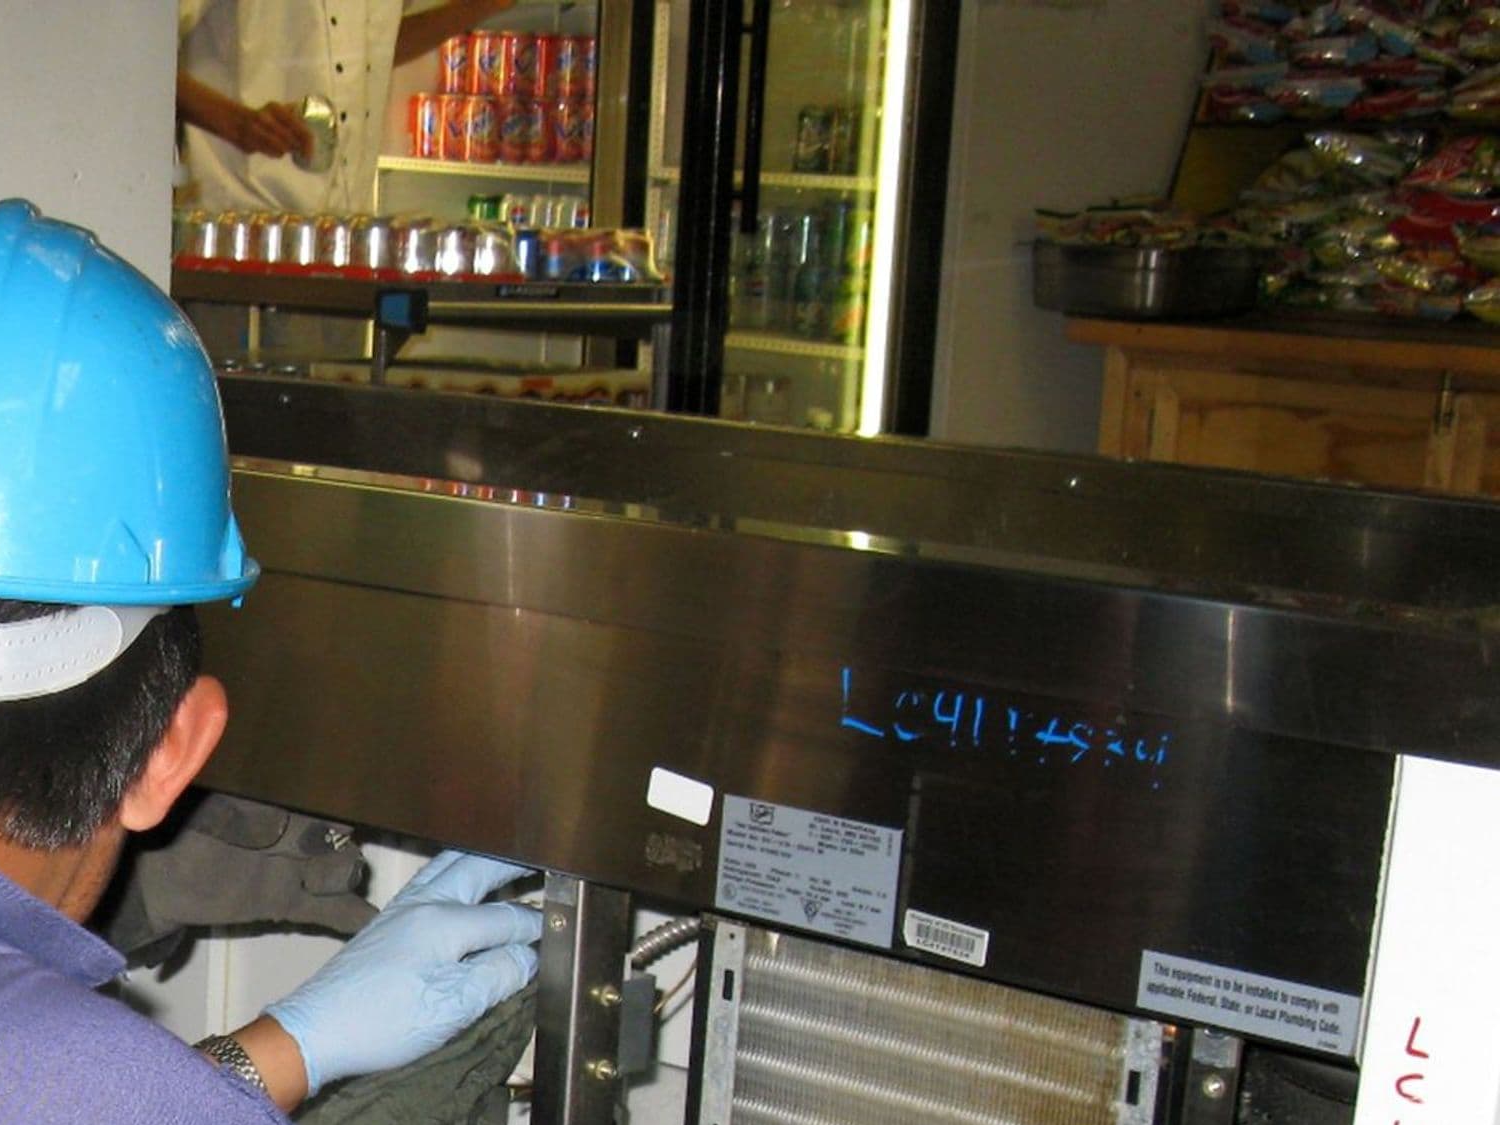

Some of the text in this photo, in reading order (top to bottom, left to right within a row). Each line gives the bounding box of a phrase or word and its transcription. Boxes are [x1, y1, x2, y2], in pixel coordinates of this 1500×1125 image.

[1146, 981, 1186, 1001] applicable
[1244, 1004, 1253, 1015] or
[1255, 1004, 1278, 1021] Local
[1279, 1009, 1318, 1032] Plumbing
[1154, 962, 1340, 1015] This equipment is to be installed to comply with
